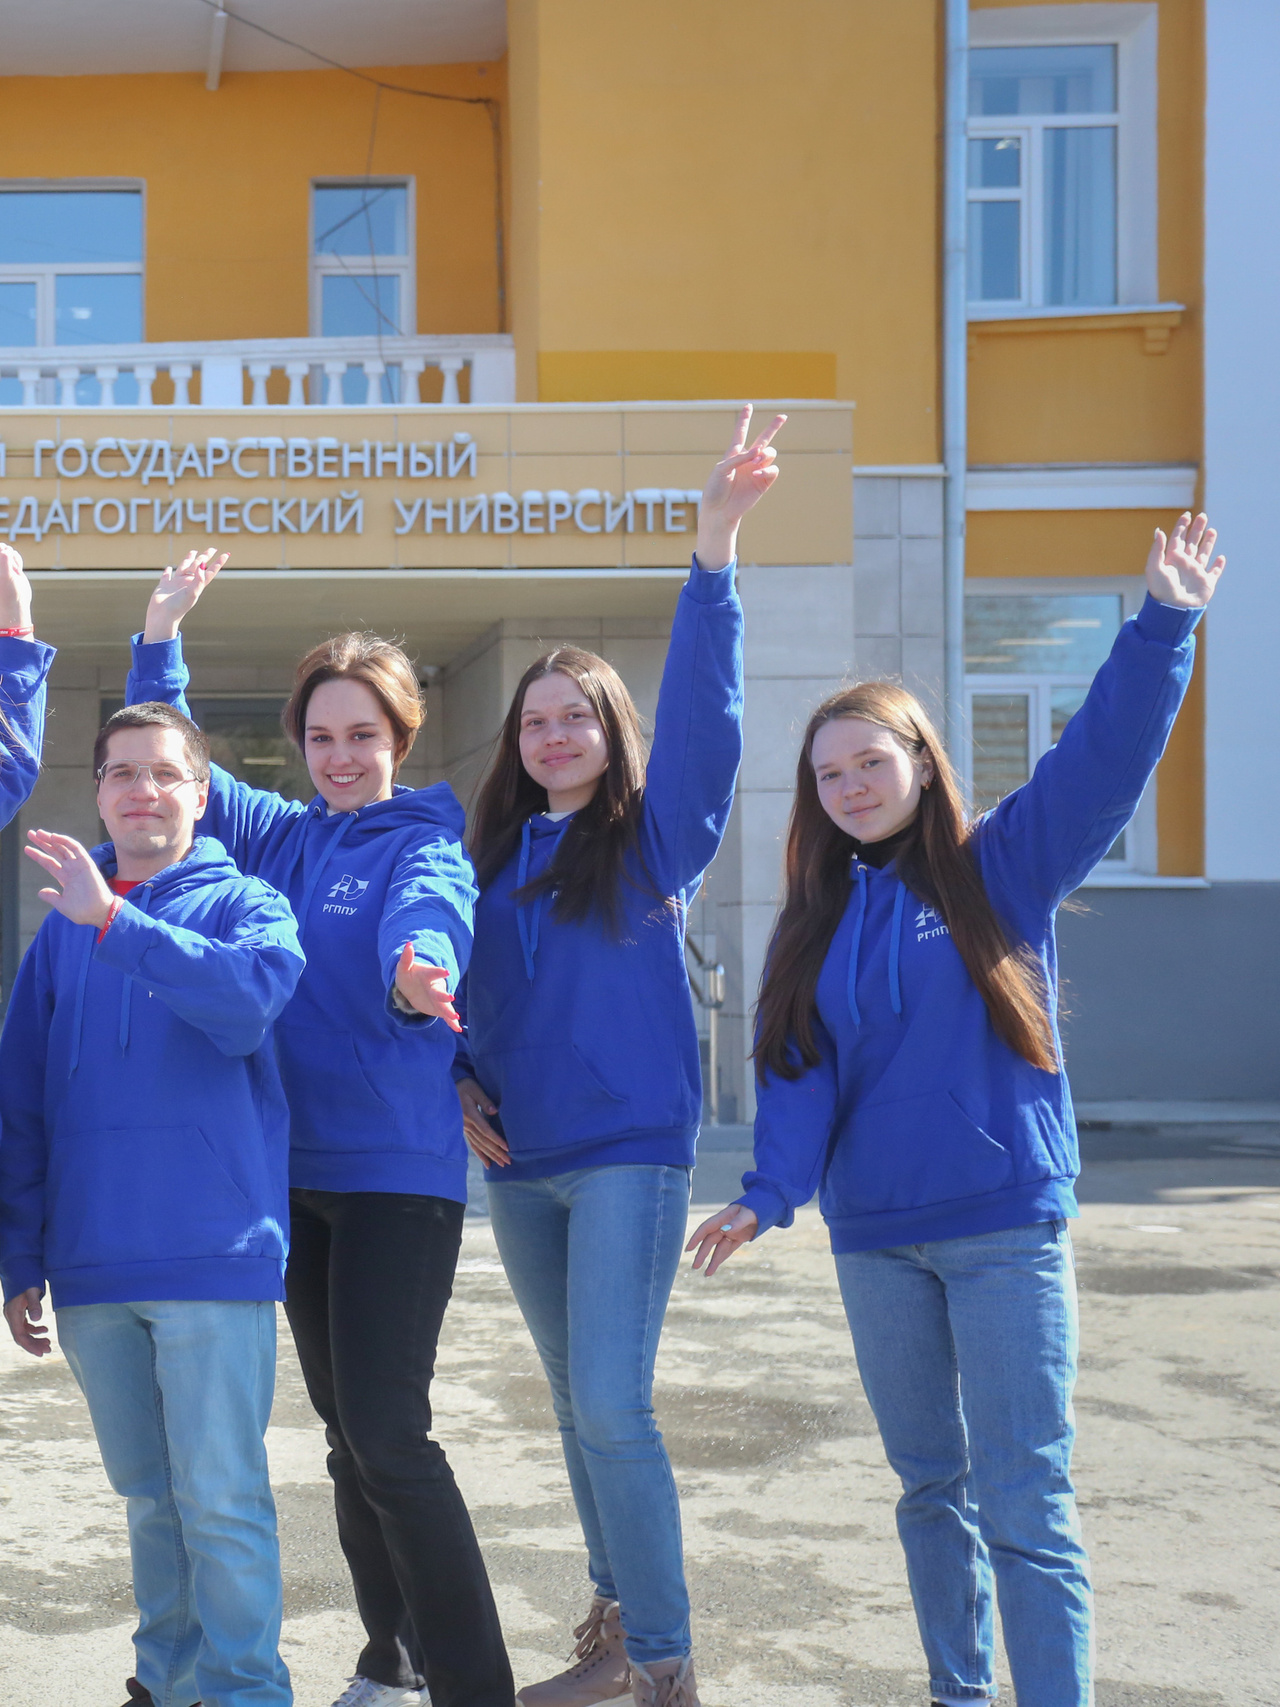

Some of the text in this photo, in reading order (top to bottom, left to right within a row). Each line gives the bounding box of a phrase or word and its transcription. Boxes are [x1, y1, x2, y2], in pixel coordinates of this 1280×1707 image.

[34, 432, 478, 485] ГОСУДАРСТВЕННЫЙ
[322, 903, 358, 916] РГППУ
[917, 925, 949, 942] РГПП
